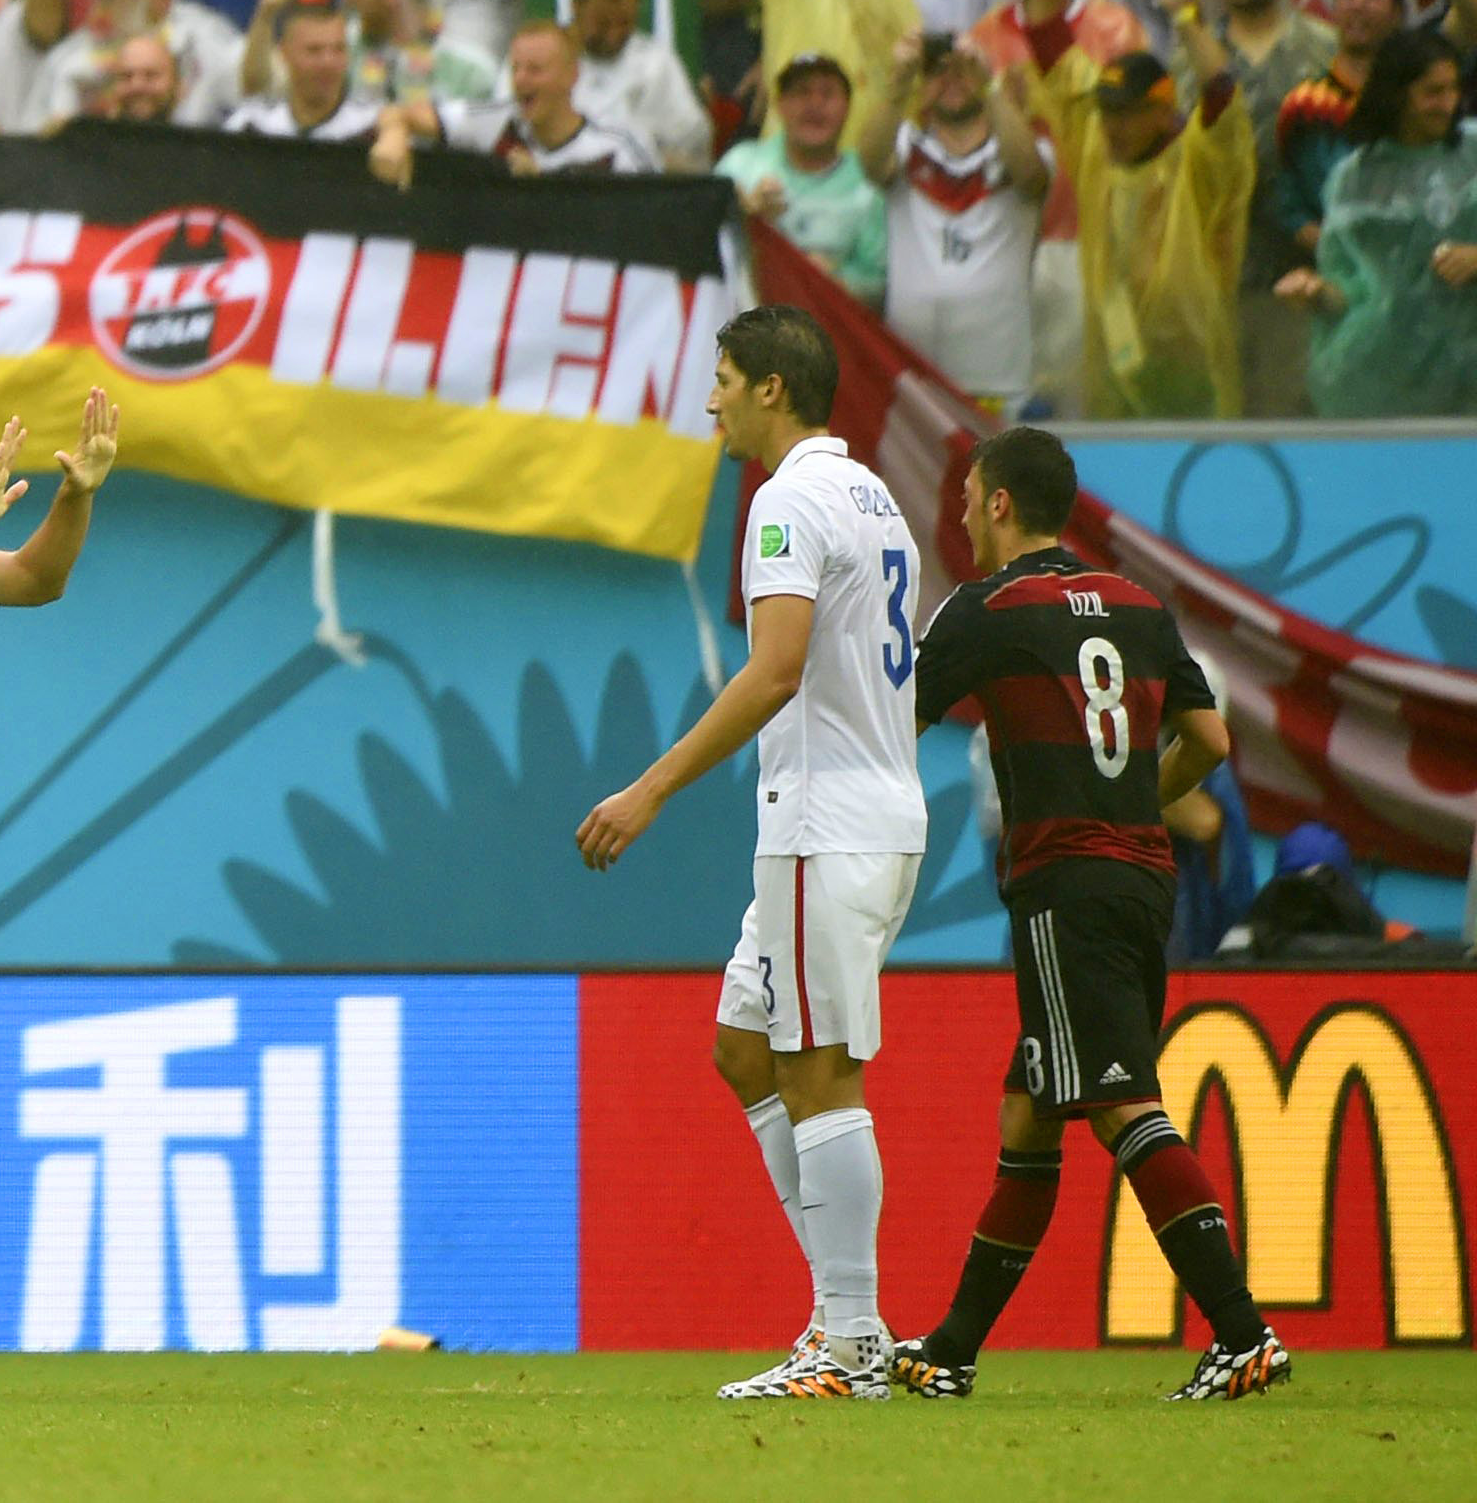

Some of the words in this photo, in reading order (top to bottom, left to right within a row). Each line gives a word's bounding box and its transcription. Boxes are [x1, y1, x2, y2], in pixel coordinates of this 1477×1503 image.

[270, 231, 737, 440] ILIEN
[882, 548, 913, 691] 3
[1063, 589, 1110, 618] ÖZIL
[1078, 636, 1130, 779] 8
[758, 955, 776, 1016] 3
[1023, 1035, 1045, 1096] 8
